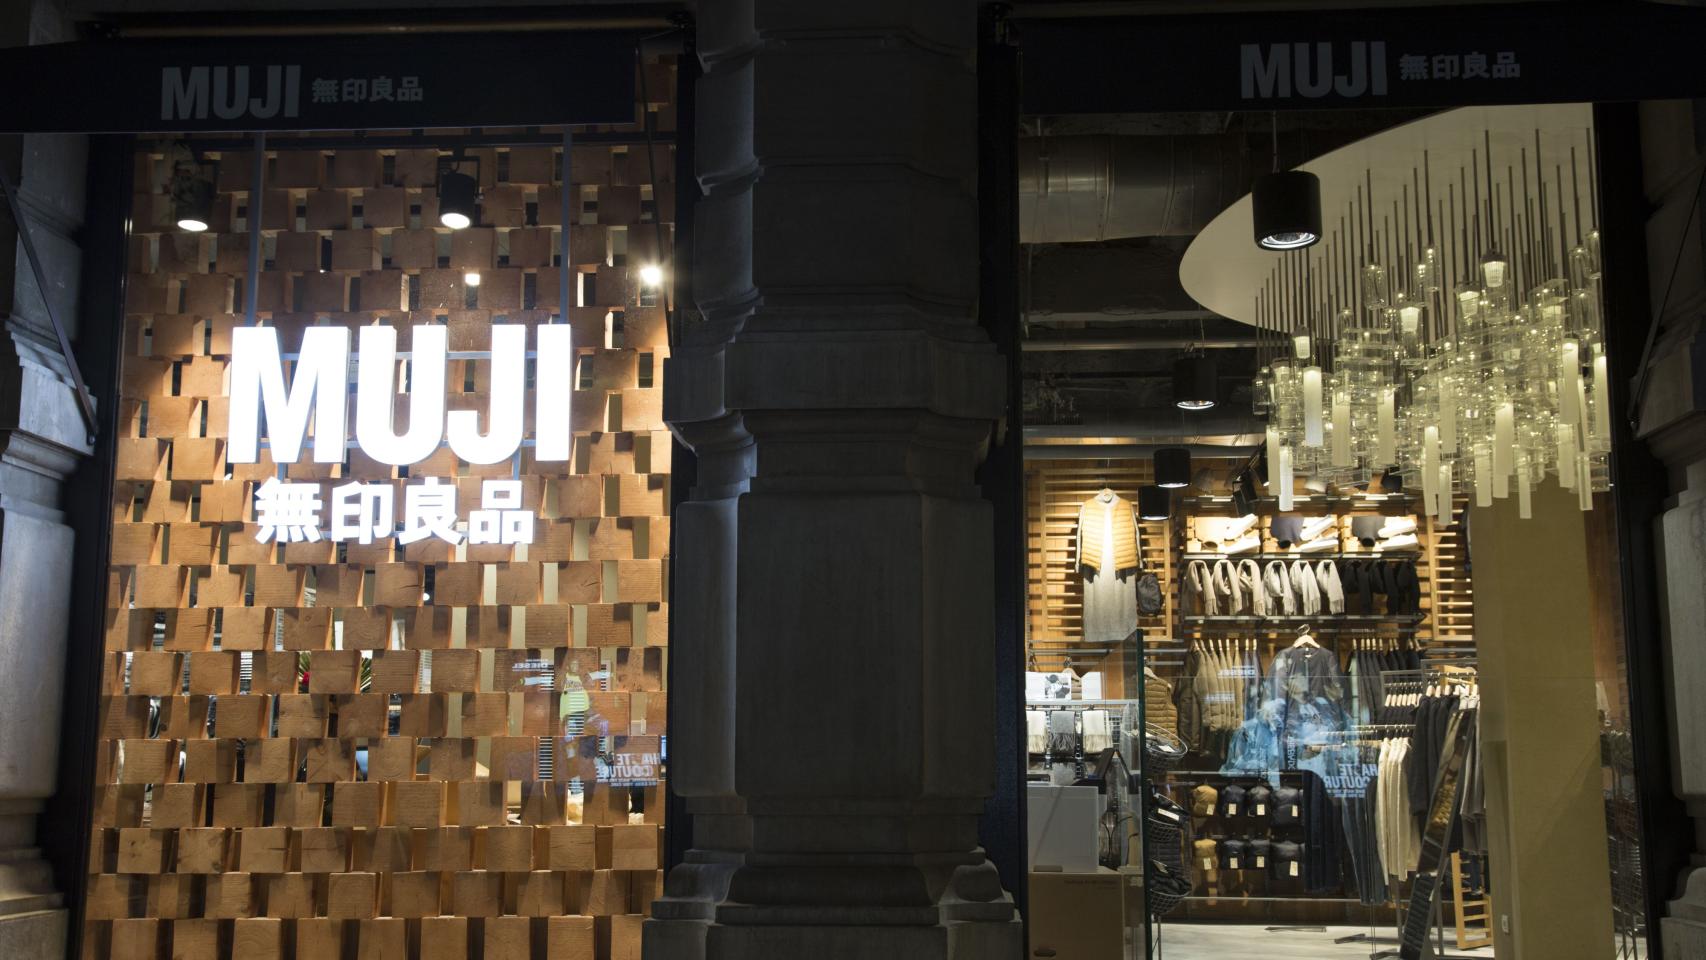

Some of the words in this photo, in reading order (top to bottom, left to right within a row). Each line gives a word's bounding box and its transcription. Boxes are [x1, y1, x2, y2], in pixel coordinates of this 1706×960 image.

[161, 65, 300, 120] MUJI
[312, 76, 423, 103] 無印良品
[1240, 41, 1388, 99] MUJI
[1399, 51, 1520, 80] 無印良品
[227, 323, 572, 466] MUJI
[255, 476, 534, 545] 無印良品
